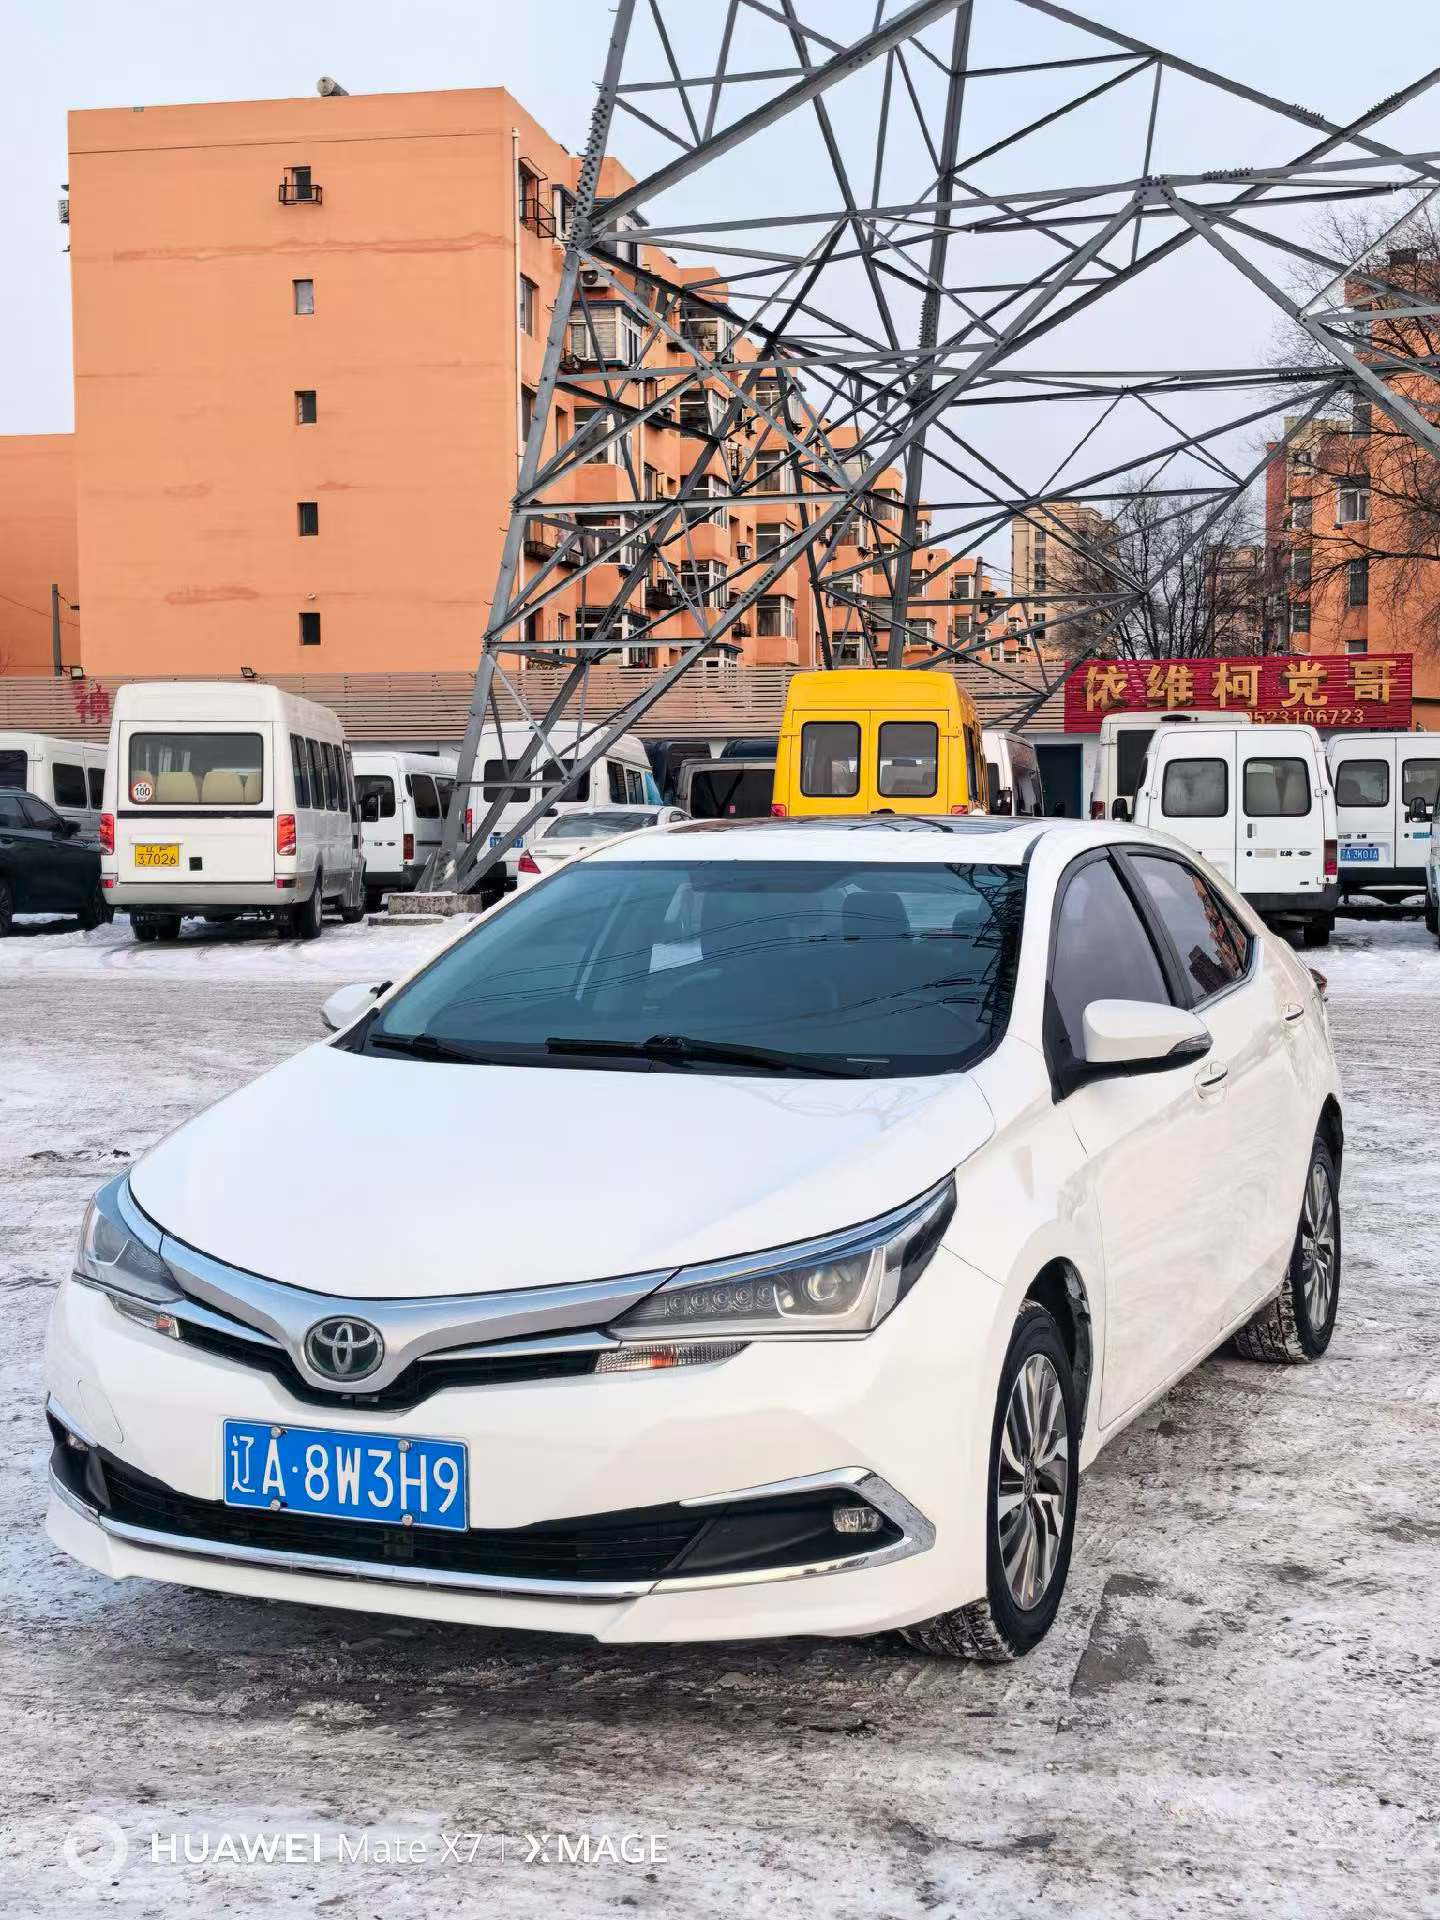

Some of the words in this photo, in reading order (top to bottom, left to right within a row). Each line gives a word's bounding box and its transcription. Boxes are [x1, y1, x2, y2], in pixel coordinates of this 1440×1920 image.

[1085, 660, 1398, 712] 依维柯党哥
[135, 787, 151, 796] 100
[231, 1434, 459, 1514] 辽A·8W3H9
